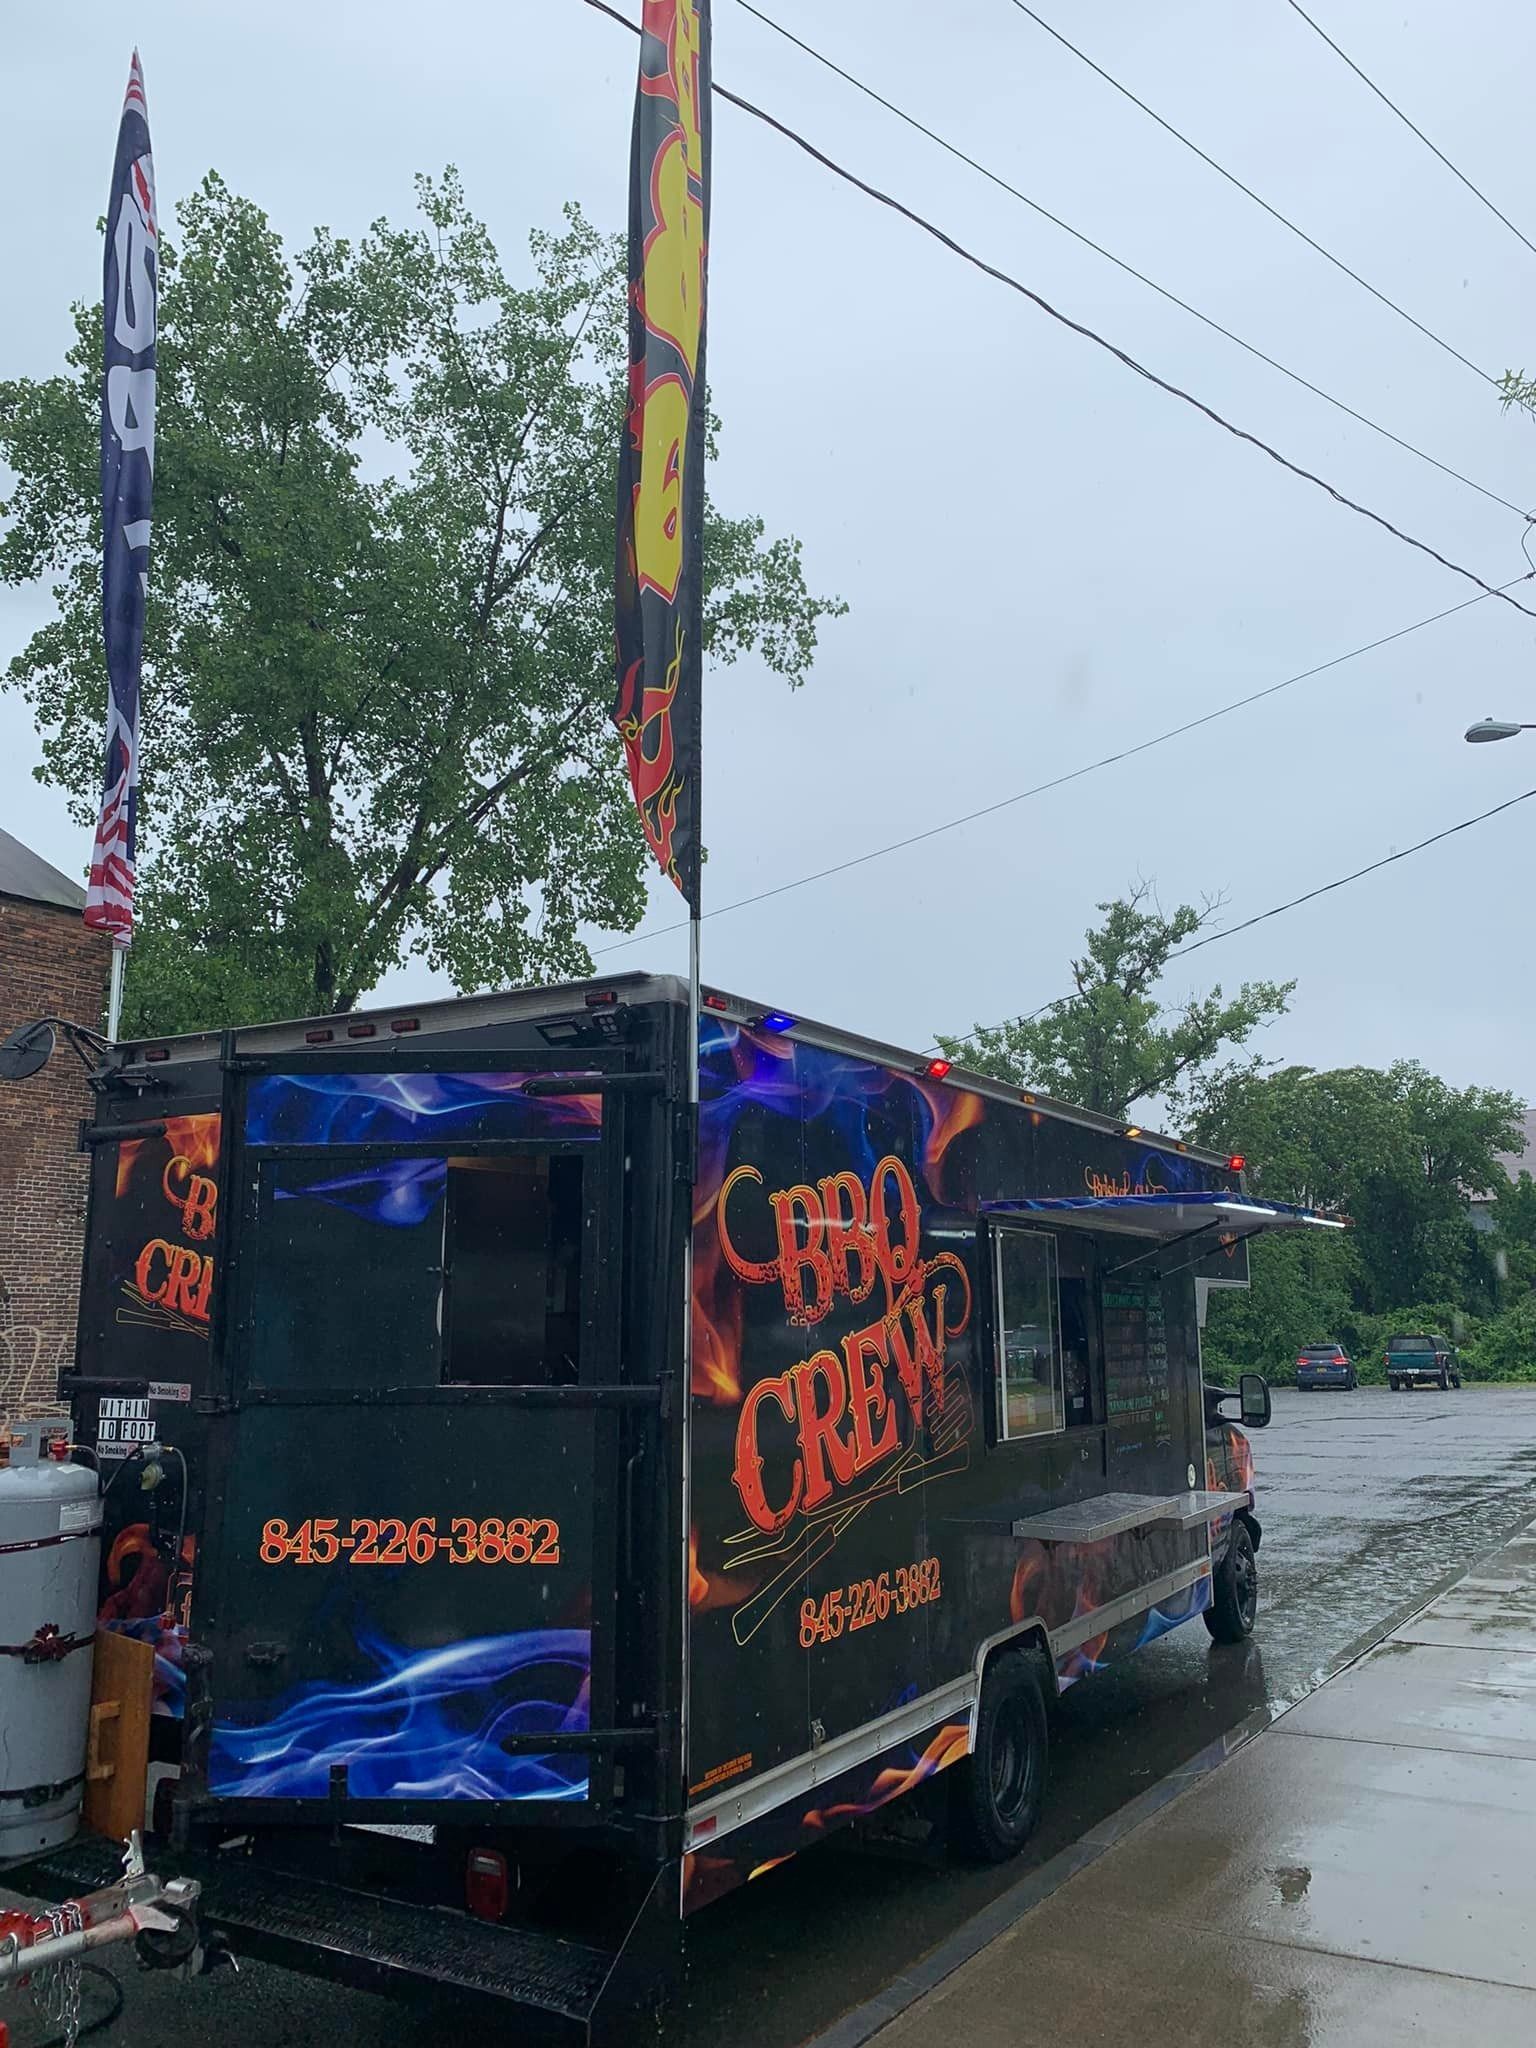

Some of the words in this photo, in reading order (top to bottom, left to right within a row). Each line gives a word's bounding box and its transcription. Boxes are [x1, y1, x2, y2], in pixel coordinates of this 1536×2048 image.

[717, 1155, 922, 1326] BBQ
[100, 1399, 148, 1418] WITHIN
[157, 1386, 180, 1399] Smoking
[732, 1284, 947, 1534] CREW
[122, 1421, 154, 1440] FOOT
[105, 1445, 128, 1457] Smoking
[259, 1517, 560, 1565] 845-226-3882
[799, 1556, 942, 1649] 845-226-3882
